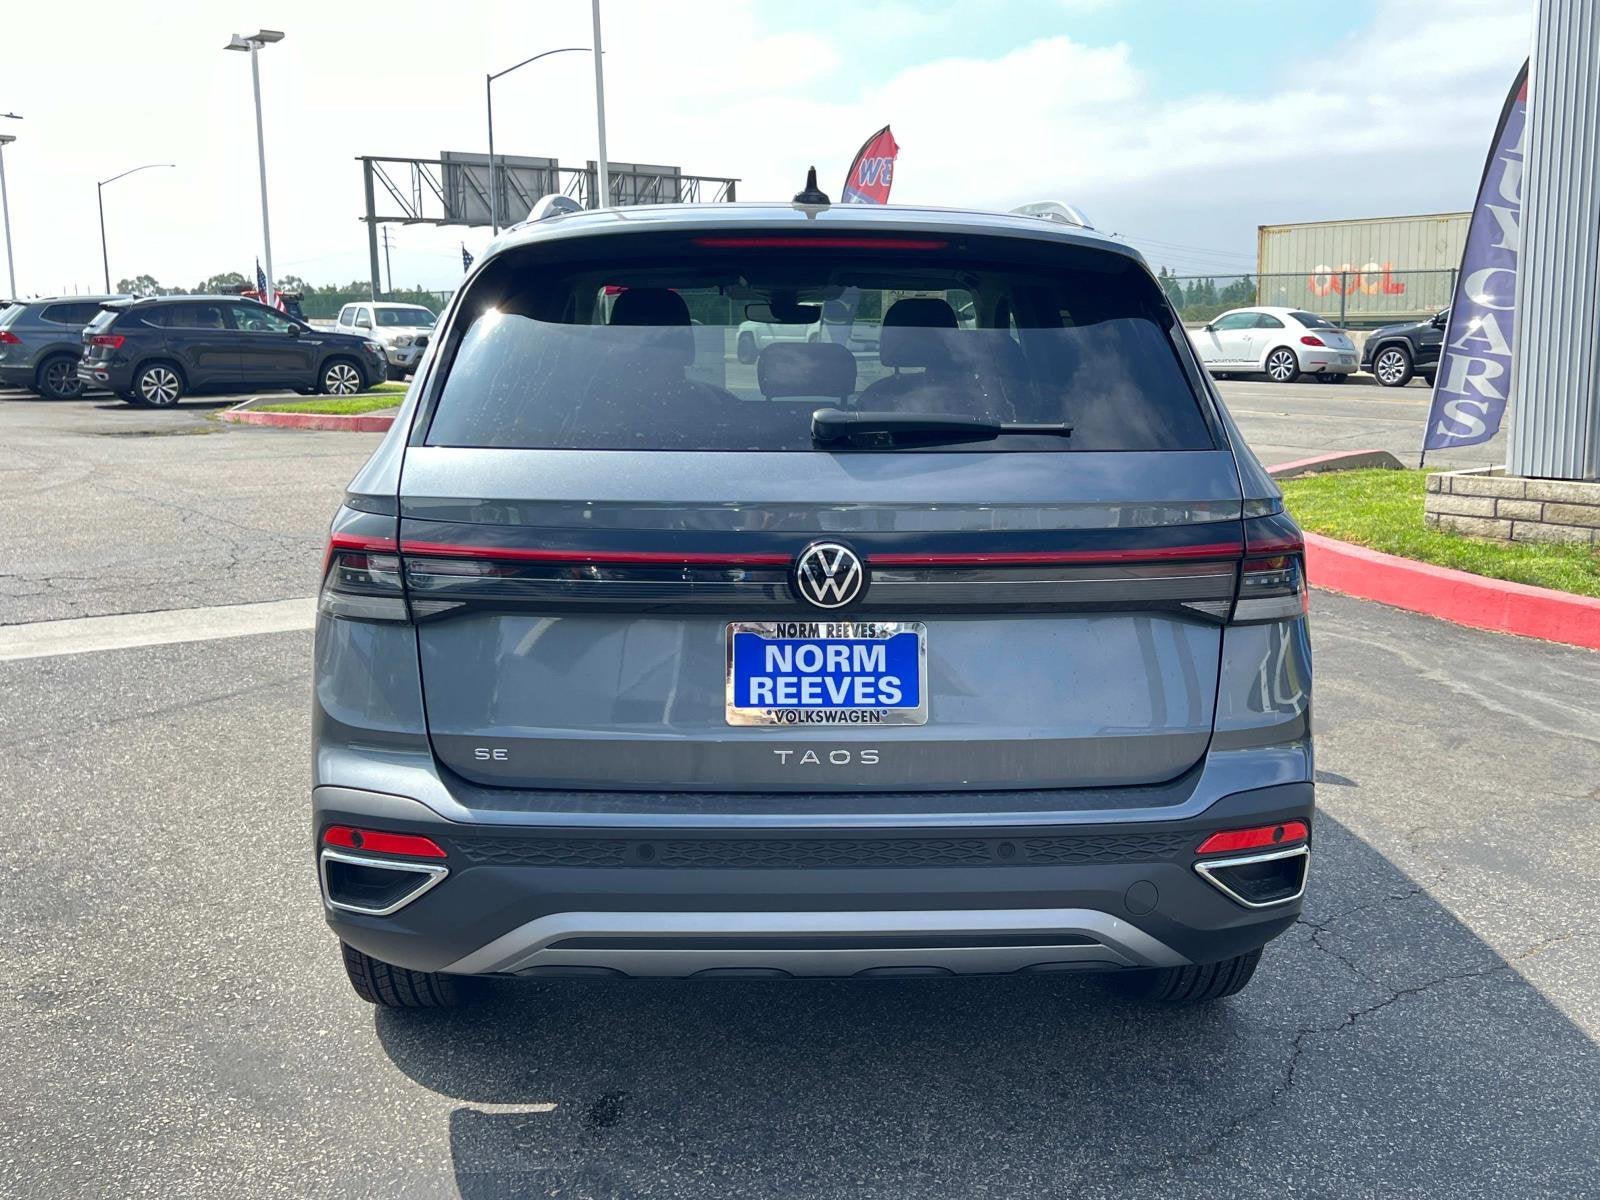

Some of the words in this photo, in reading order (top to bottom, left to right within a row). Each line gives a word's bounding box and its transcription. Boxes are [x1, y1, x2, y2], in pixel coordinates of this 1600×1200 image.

[859, 157, 893, 187] WE
[1436, 267, 1516, 438] CARS
[801, 545, 859, 604] VW
[776, 623, 820, 638] NORM
[826, 623, 876, 638] REEVES
[765, 645, 886, 673] NORM
[749, 676, 902, 705] REEVES
[775, 710, 880, 723] VOLKSWAGEN
[474, 748, 509, 761] SE
[774, 749, 880, 765] TAOS
